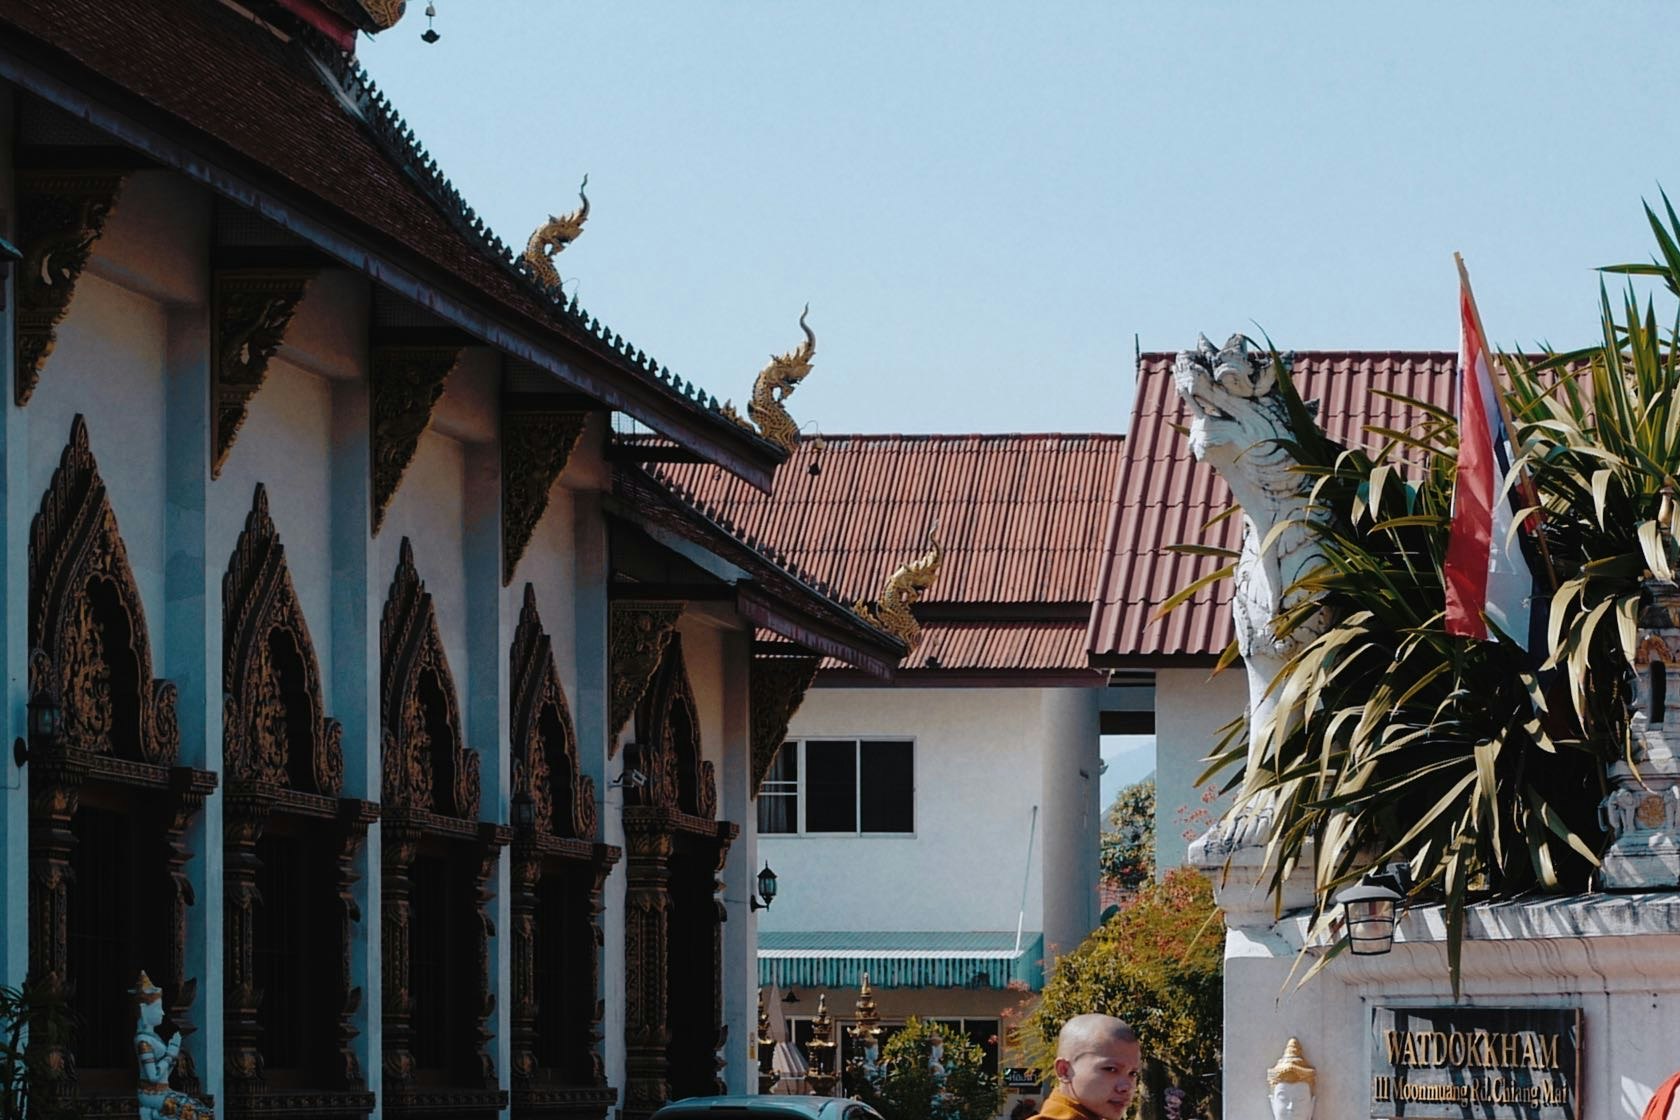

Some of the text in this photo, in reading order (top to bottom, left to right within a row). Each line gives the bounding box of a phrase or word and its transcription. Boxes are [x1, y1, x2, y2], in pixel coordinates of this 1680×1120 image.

[1384, 1030, 1559, 1069] WATDOKKHAM
[1374, 1076, 1389, 1100] 111
[1392, 1077, 1468, 1107] Moonmuang
[1540, 1079, 1567, 1104] Mai
